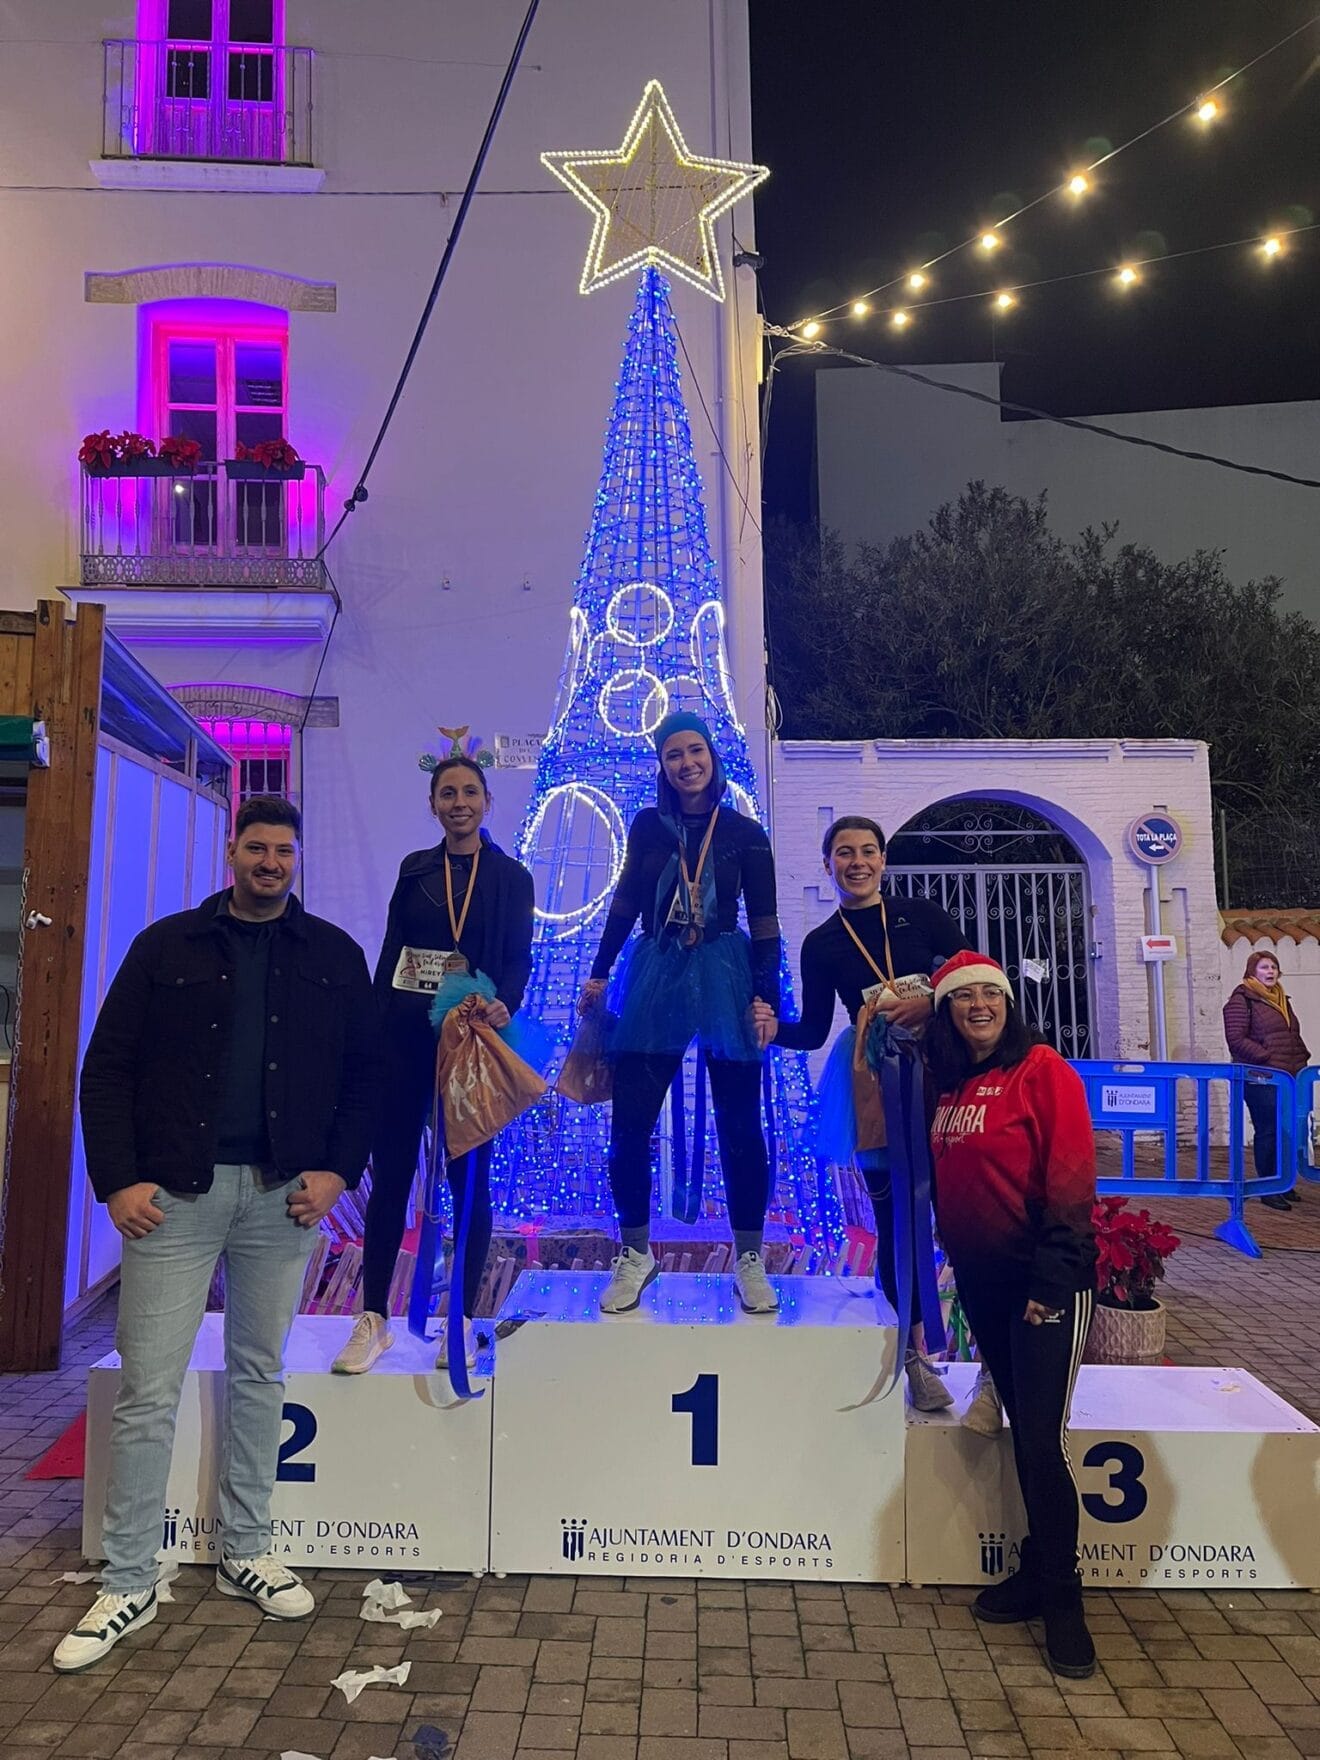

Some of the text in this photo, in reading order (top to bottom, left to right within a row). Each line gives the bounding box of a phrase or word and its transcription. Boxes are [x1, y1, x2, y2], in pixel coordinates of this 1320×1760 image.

[1136, 832, 1177, 843] TOTA LA PLAÇA
[671, 1374, 719, 1467] 1
[275, 1402, 318, 1482] 2
[1081, 1441, 1148, 1524] 3
[316, 1521, 419, 1540] D'ONDARA
[588, 1528, 832, 1551] AJUNTAMENT D'ONDARA
[180, 1540, 421, 1557] REGIA D'ESPORTS
[1150, 1545, 1255, 1563] D'ONDARA
[588, 1551, 834, 1568] REGIDORIA D'ESPORTS
[1140, 1568, 1257, 1579] D'ESPORTS
